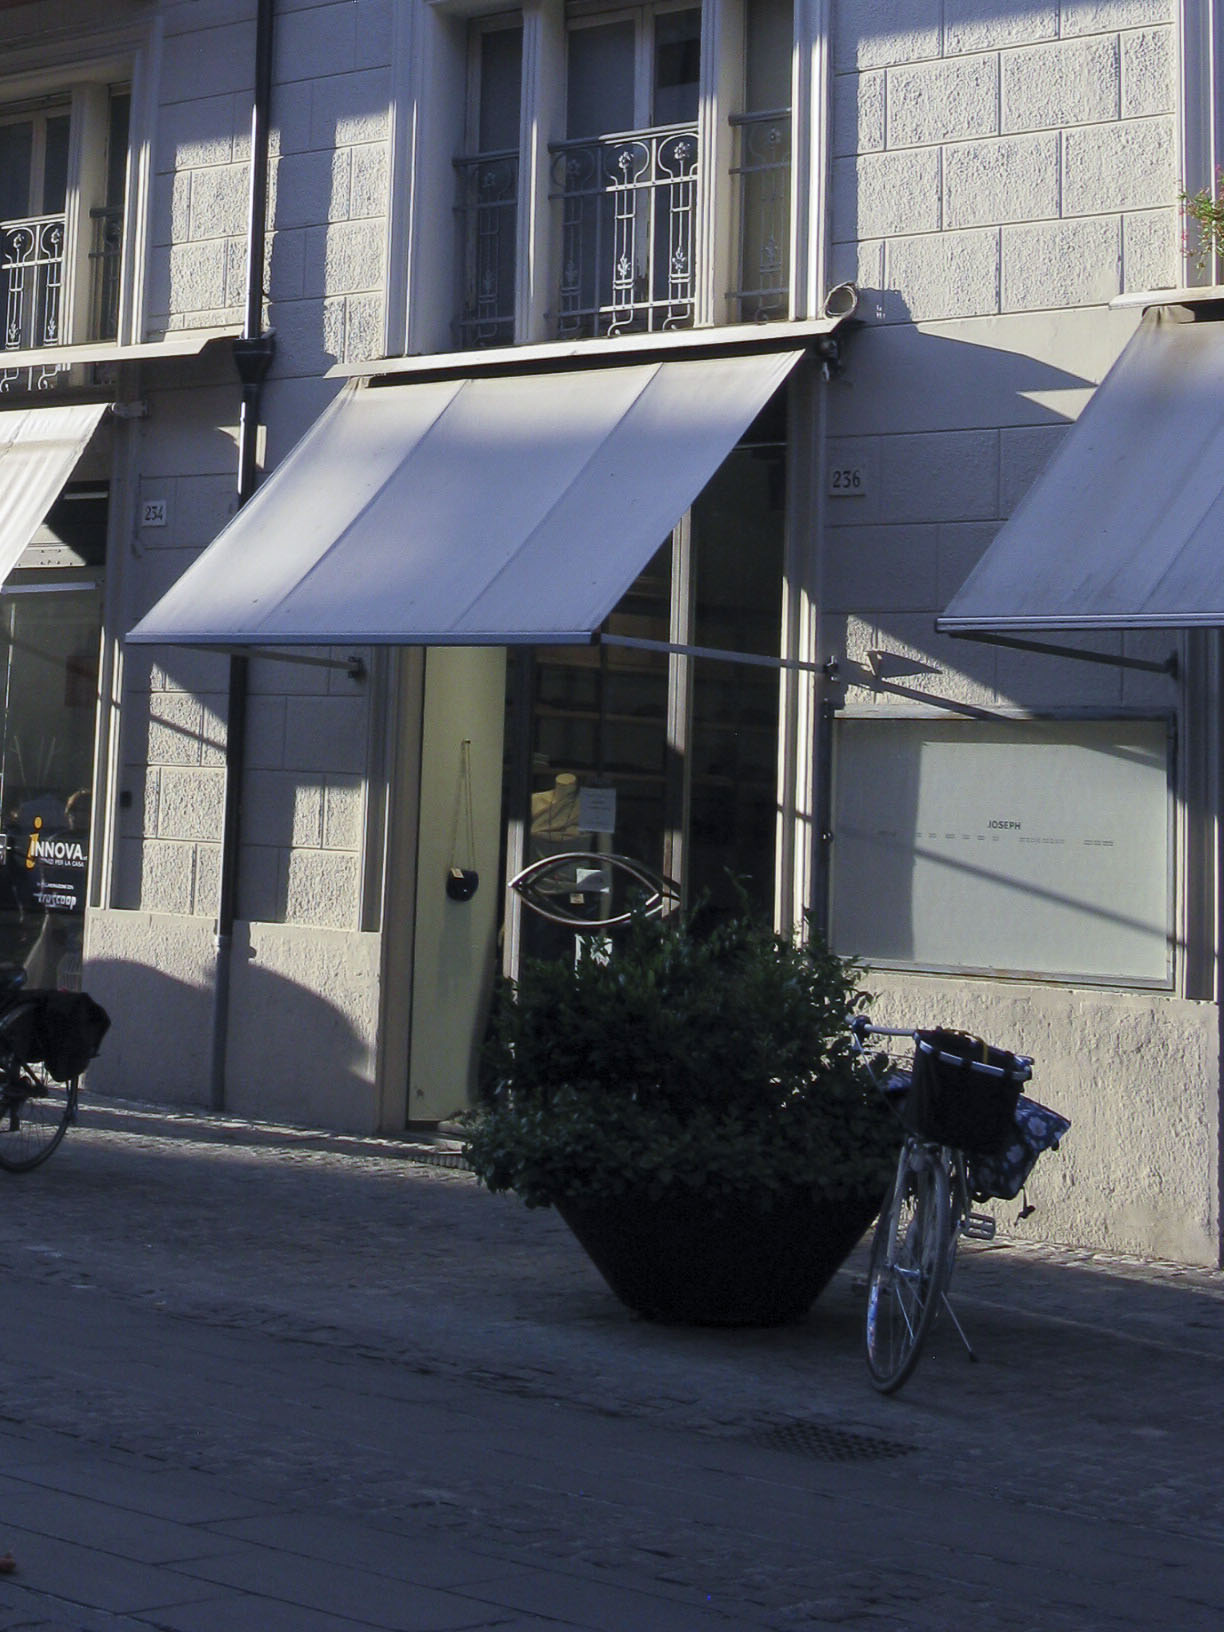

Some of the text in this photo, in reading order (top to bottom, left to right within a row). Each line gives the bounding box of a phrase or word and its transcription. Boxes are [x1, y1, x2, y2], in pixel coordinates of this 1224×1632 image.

[832, 470, 861, 488] 236
[144, 505, 164, 521] 234
[987, 820, 1022, 831] JOSEPH
